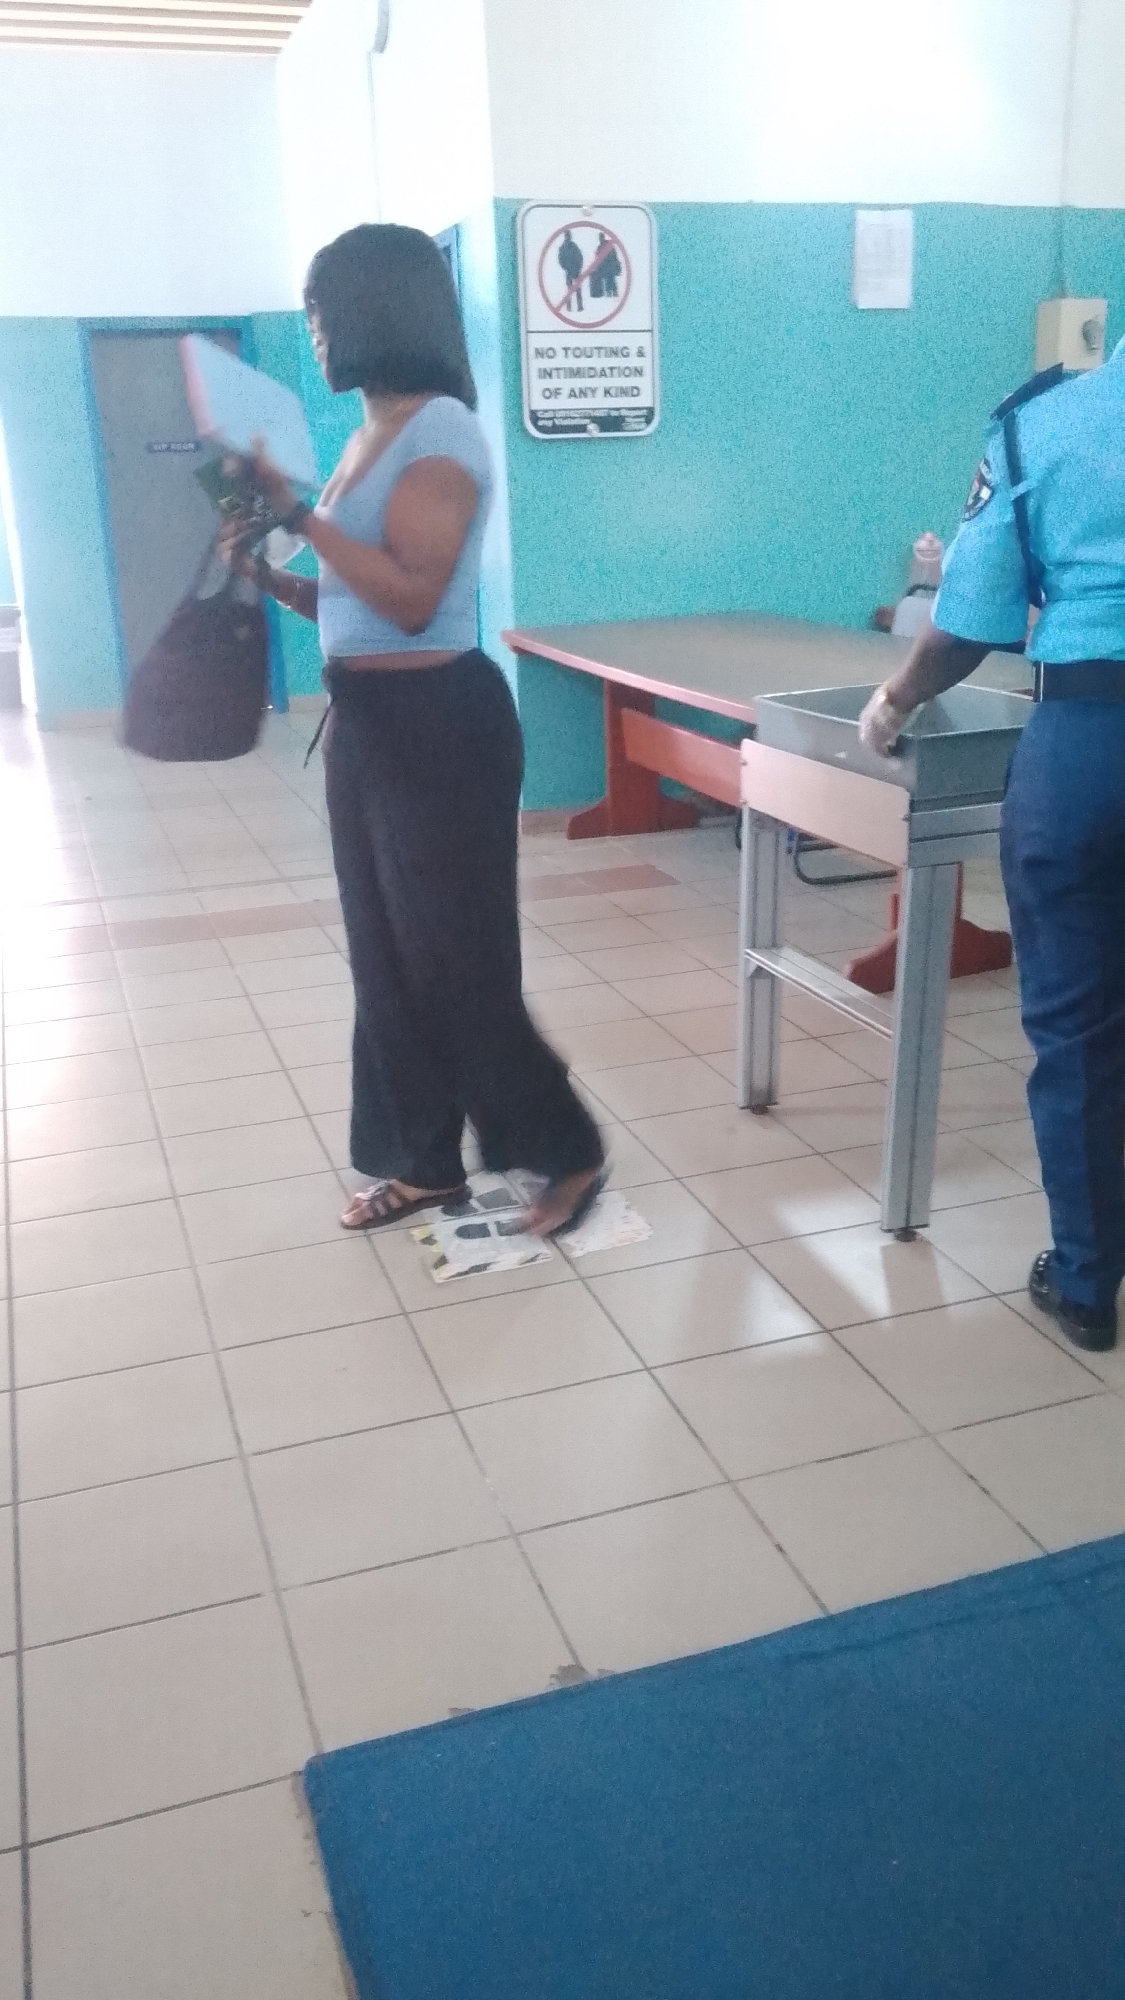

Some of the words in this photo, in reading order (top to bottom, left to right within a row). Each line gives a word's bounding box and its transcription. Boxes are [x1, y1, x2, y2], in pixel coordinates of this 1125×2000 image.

[534, 347, 557, 359] NO
[562, 346, 630, 359] TOUTING
[636, 346, 646, 358] &
[538, 366, 644, 379] INTIMIDATION
[542, 387, 562, 400] OF
[567, 386, 598, 399] ANY
[603, 386, 641, 398] KIND
